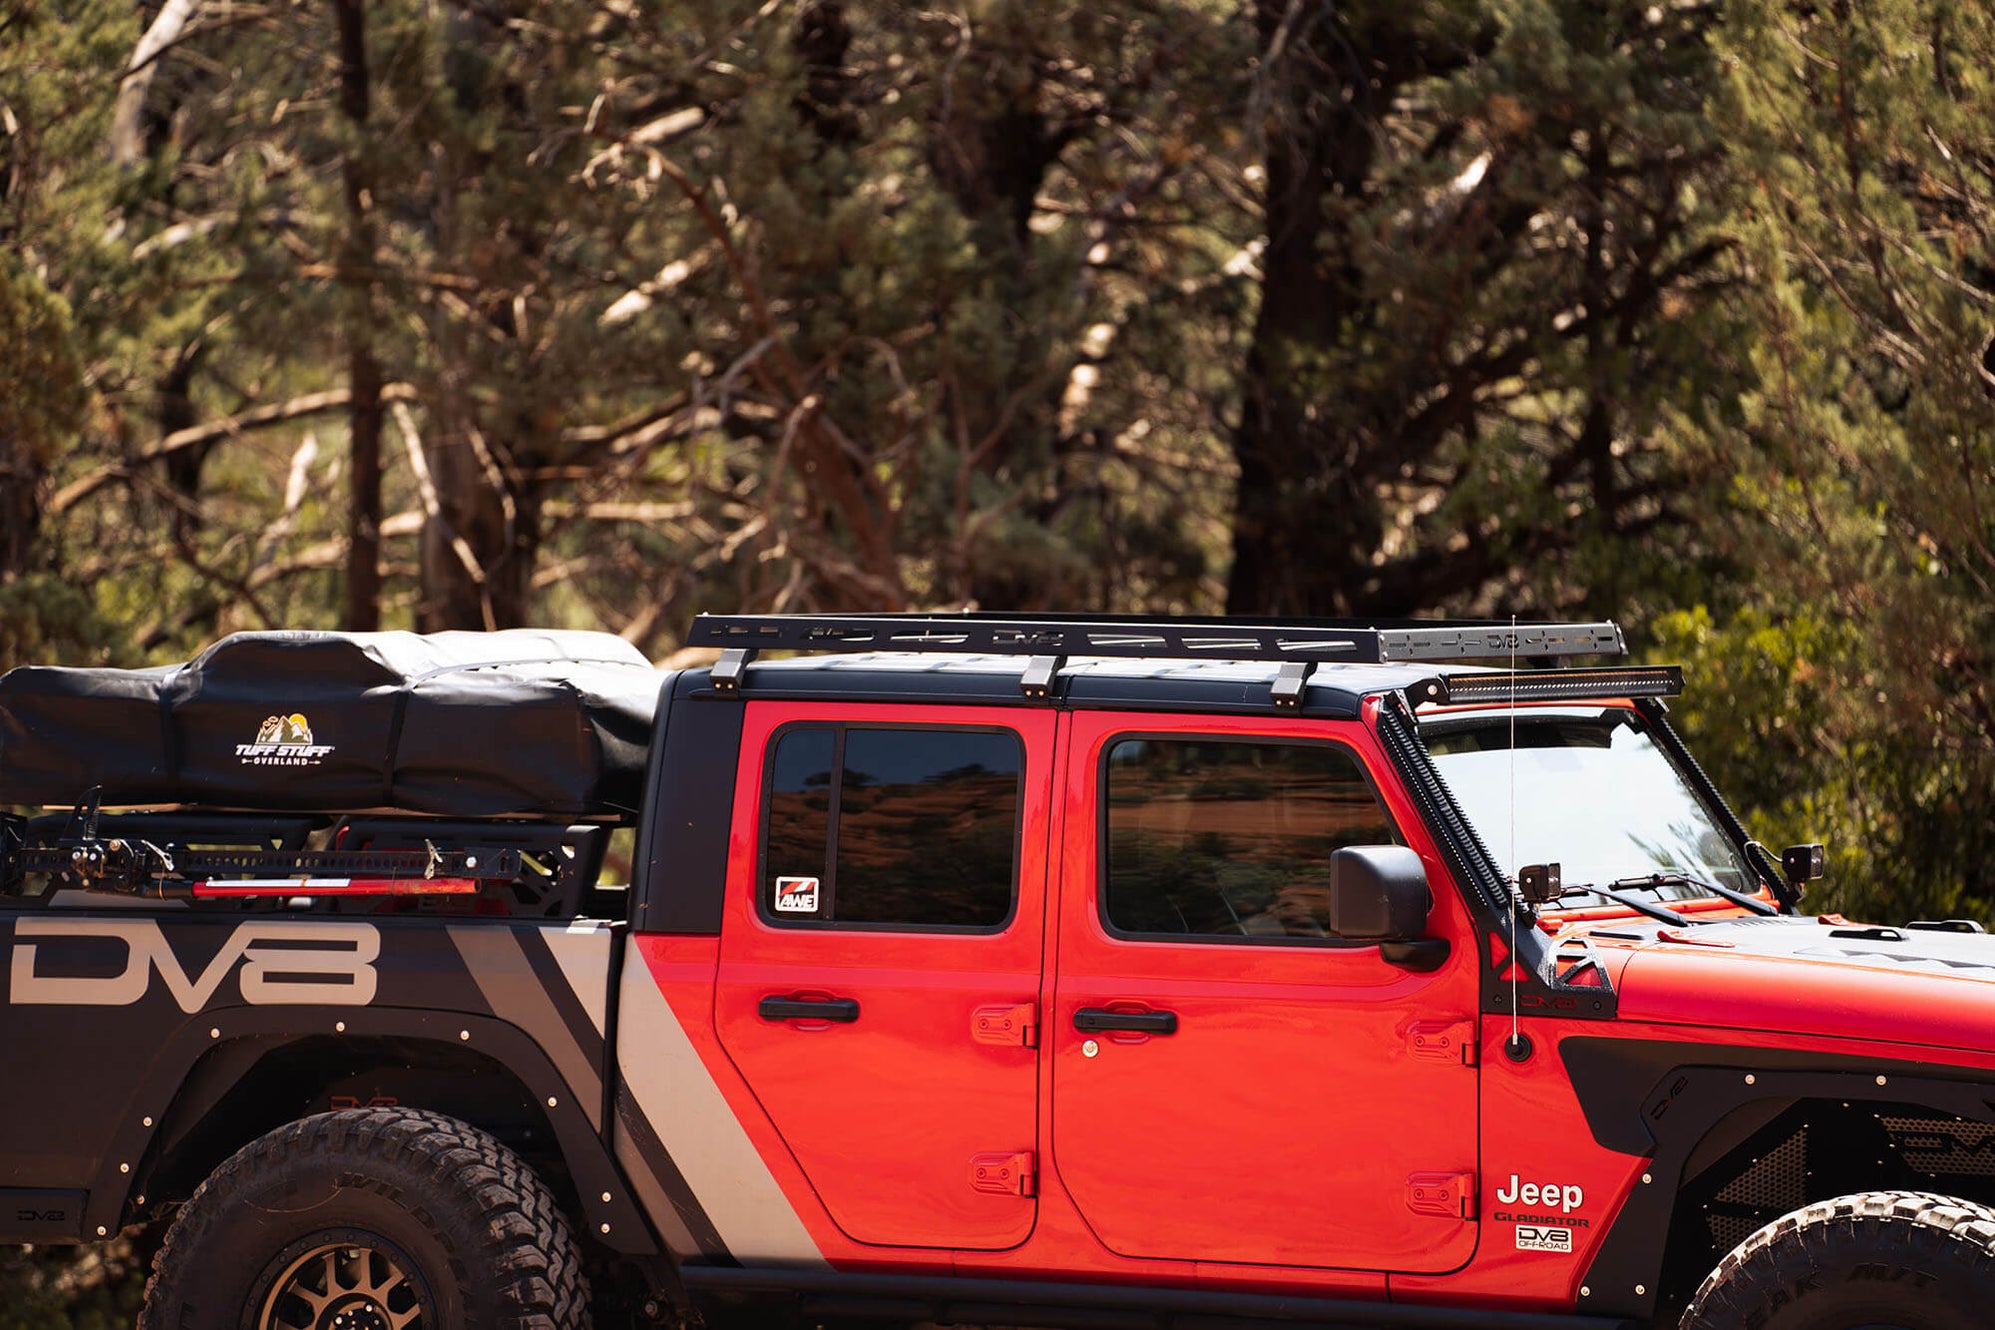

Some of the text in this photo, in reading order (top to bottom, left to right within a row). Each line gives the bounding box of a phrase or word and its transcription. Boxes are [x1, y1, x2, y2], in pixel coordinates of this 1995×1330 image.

[235, 744, 332, 757] TUFF STUFF
[253, 757, 308, 766] OVERLAND
[779, 894, 815, 909] AWE
[9, 916, 380, 1014] DV8
[1497, 1174, 1583, 1214] Jeep
[17, 1210, 65, 1221] DV8
[1493, 1211, 1590, 1228] GLADIATOR
[1518, 1227, 1569, 1242] DV8
